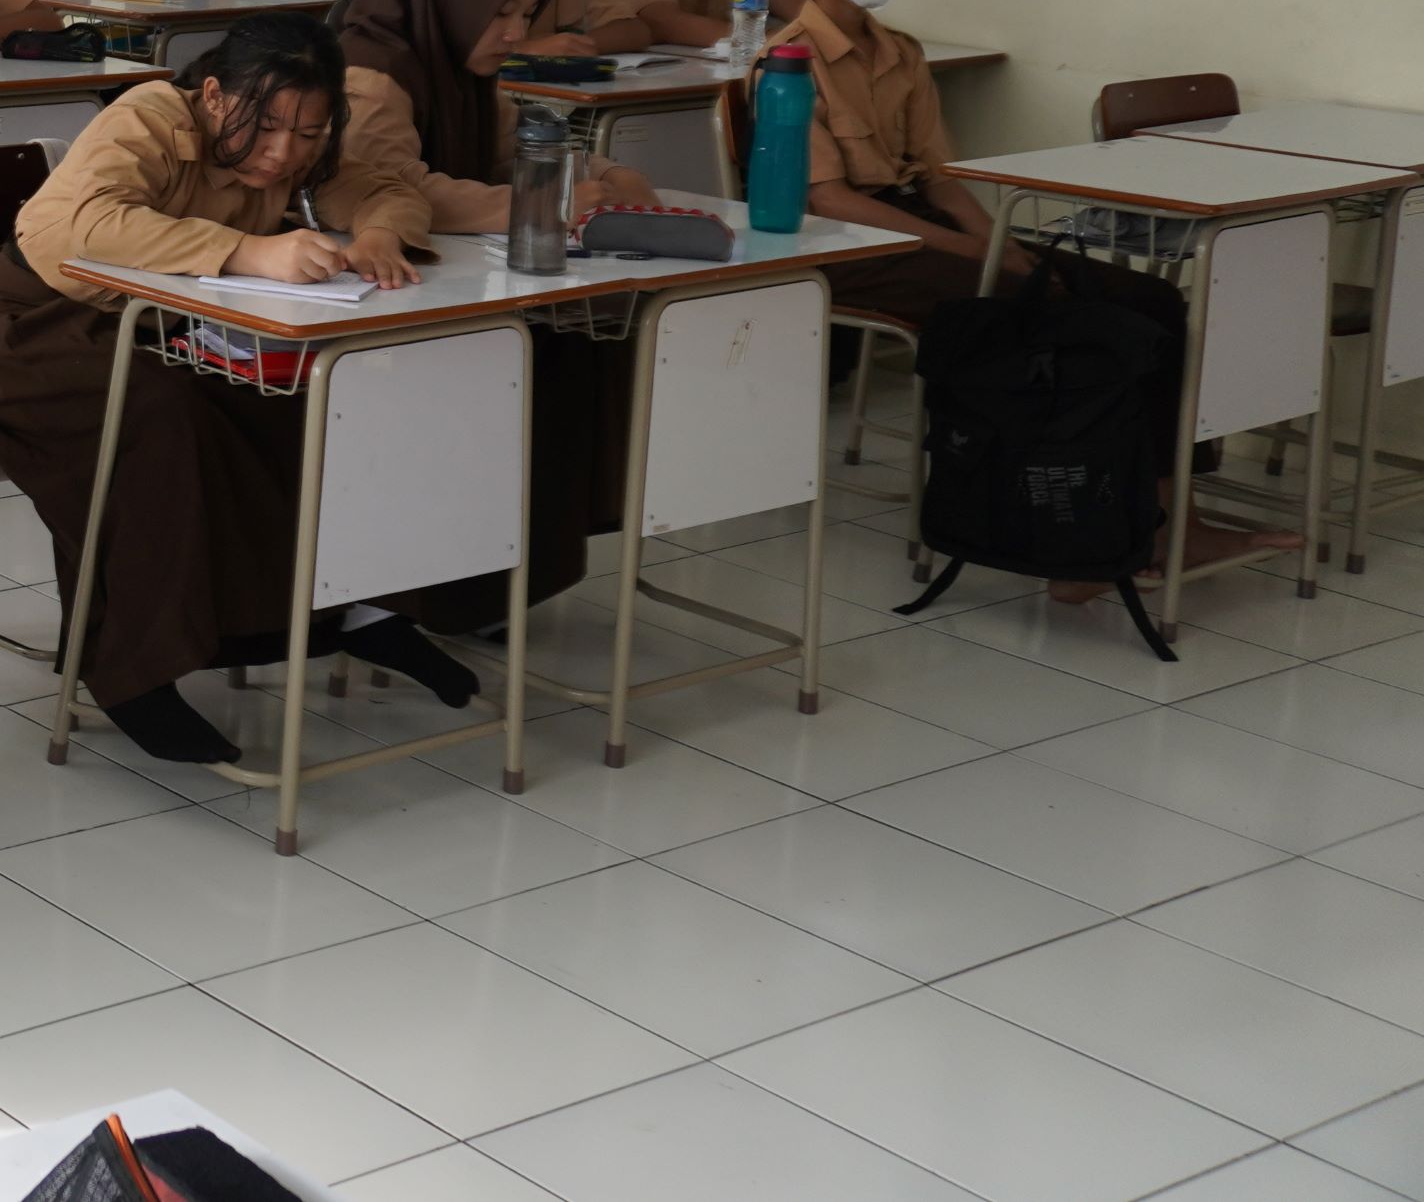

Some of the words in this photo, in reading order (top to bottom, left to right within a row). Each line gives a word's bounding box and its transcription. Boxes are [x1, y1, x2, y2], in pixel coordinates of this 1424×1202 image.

[1026, 466, 1049, 506] FORCE
[1048, 466, 1074, 524] ULTIMATE
[1066, 465, 1087, 486] THE
